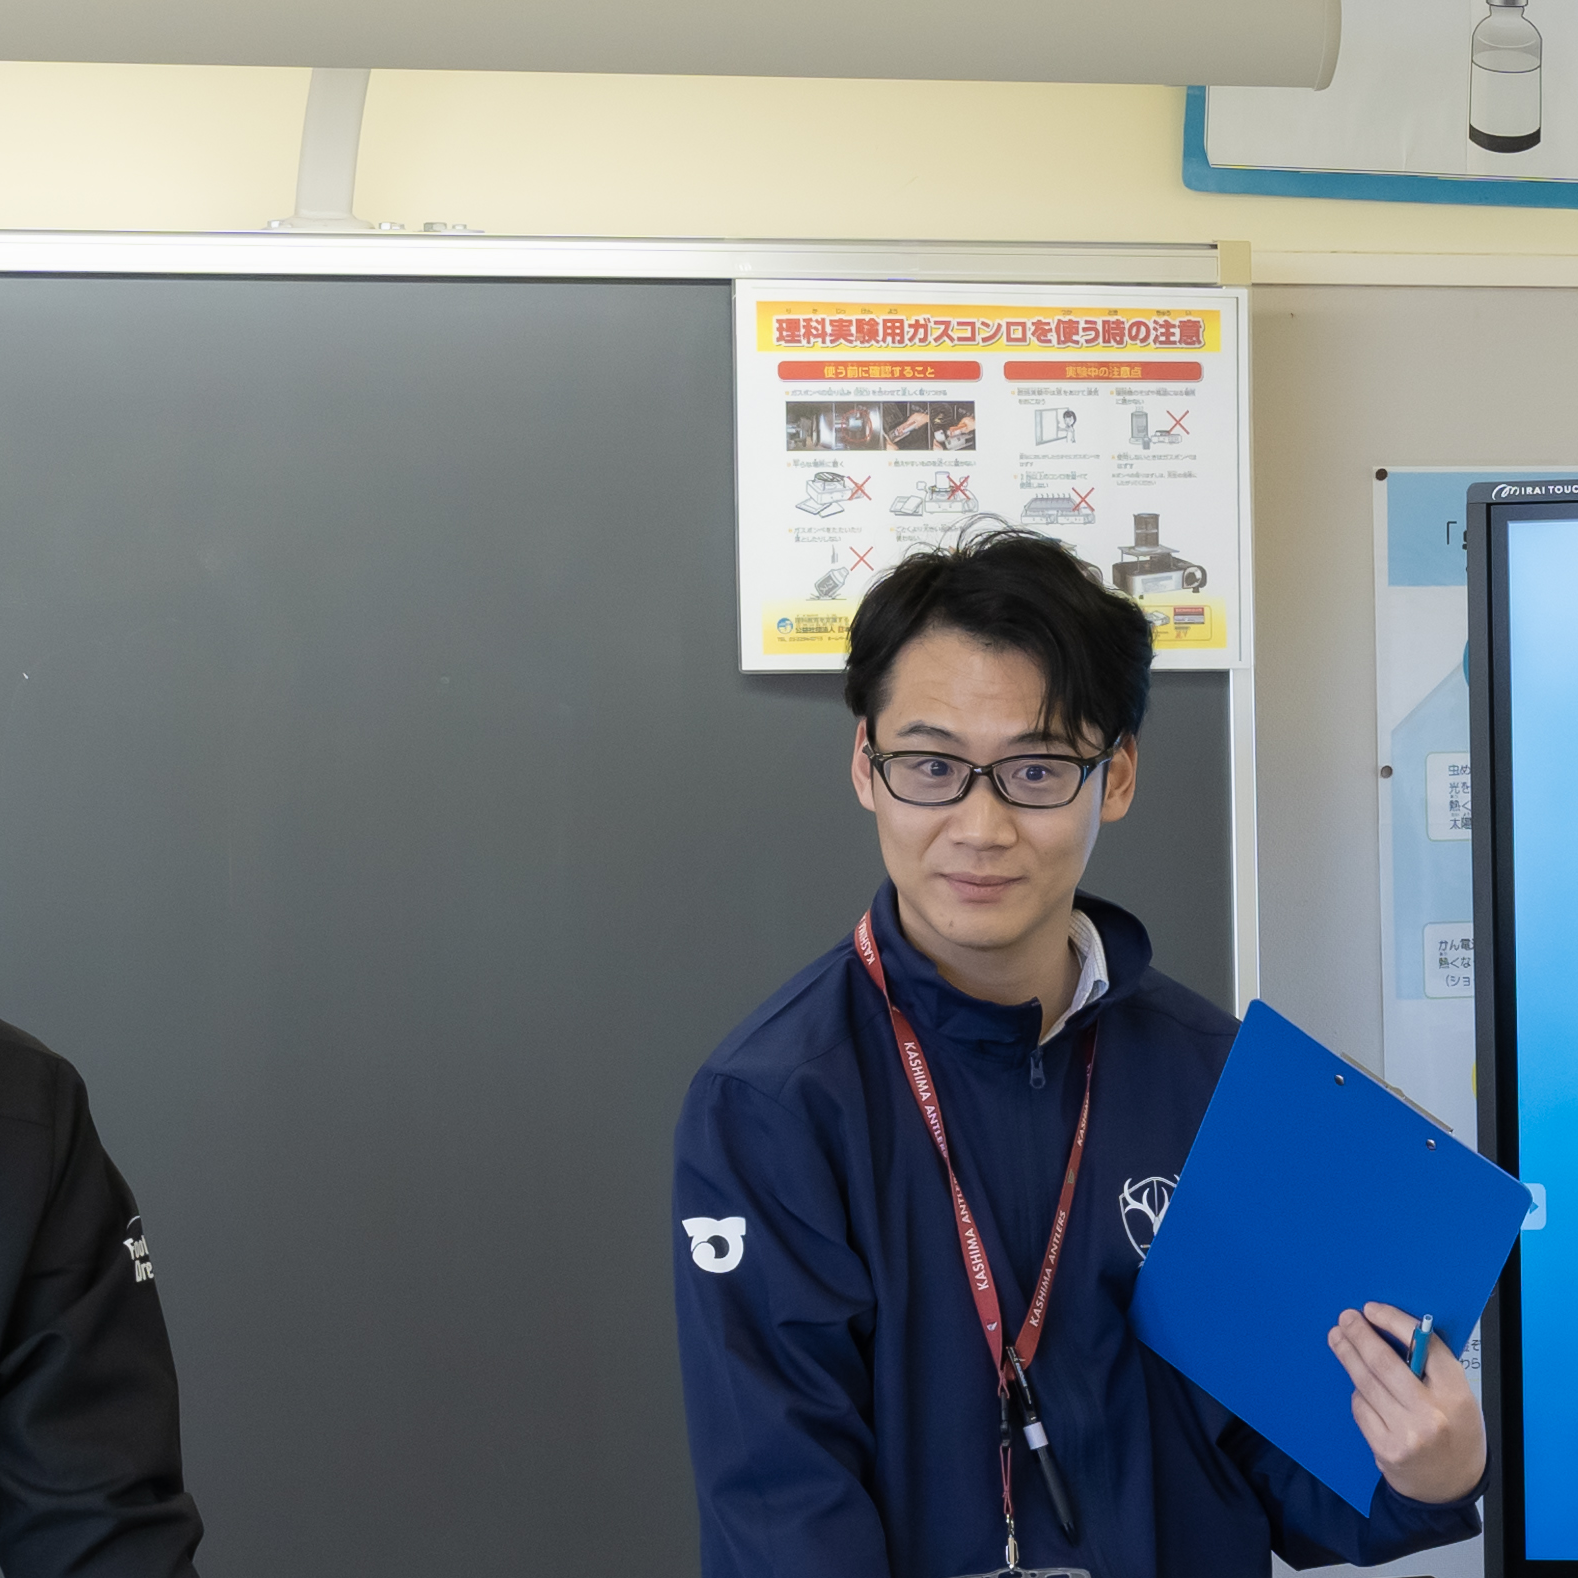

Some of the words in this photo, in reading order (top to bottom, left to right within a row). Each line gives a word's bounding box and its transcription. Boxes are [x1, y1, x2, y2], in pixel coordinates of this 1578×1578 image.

[776, 316, 1204, 347] 理科実験用ガスコンロを使う時の注意
[824, 365, 935, 378] 使う前に確認すること
[1066, 365, 1142, 379] 実験中の注意点
[903, 1041, 931, 1101] KASHIMA
[964, 1227, 990, 1292] KASHIMA
[1028, 1268, 1052, 1328] KASHIMA
[1048, 1209, 1066, 1265] ANTLERS
